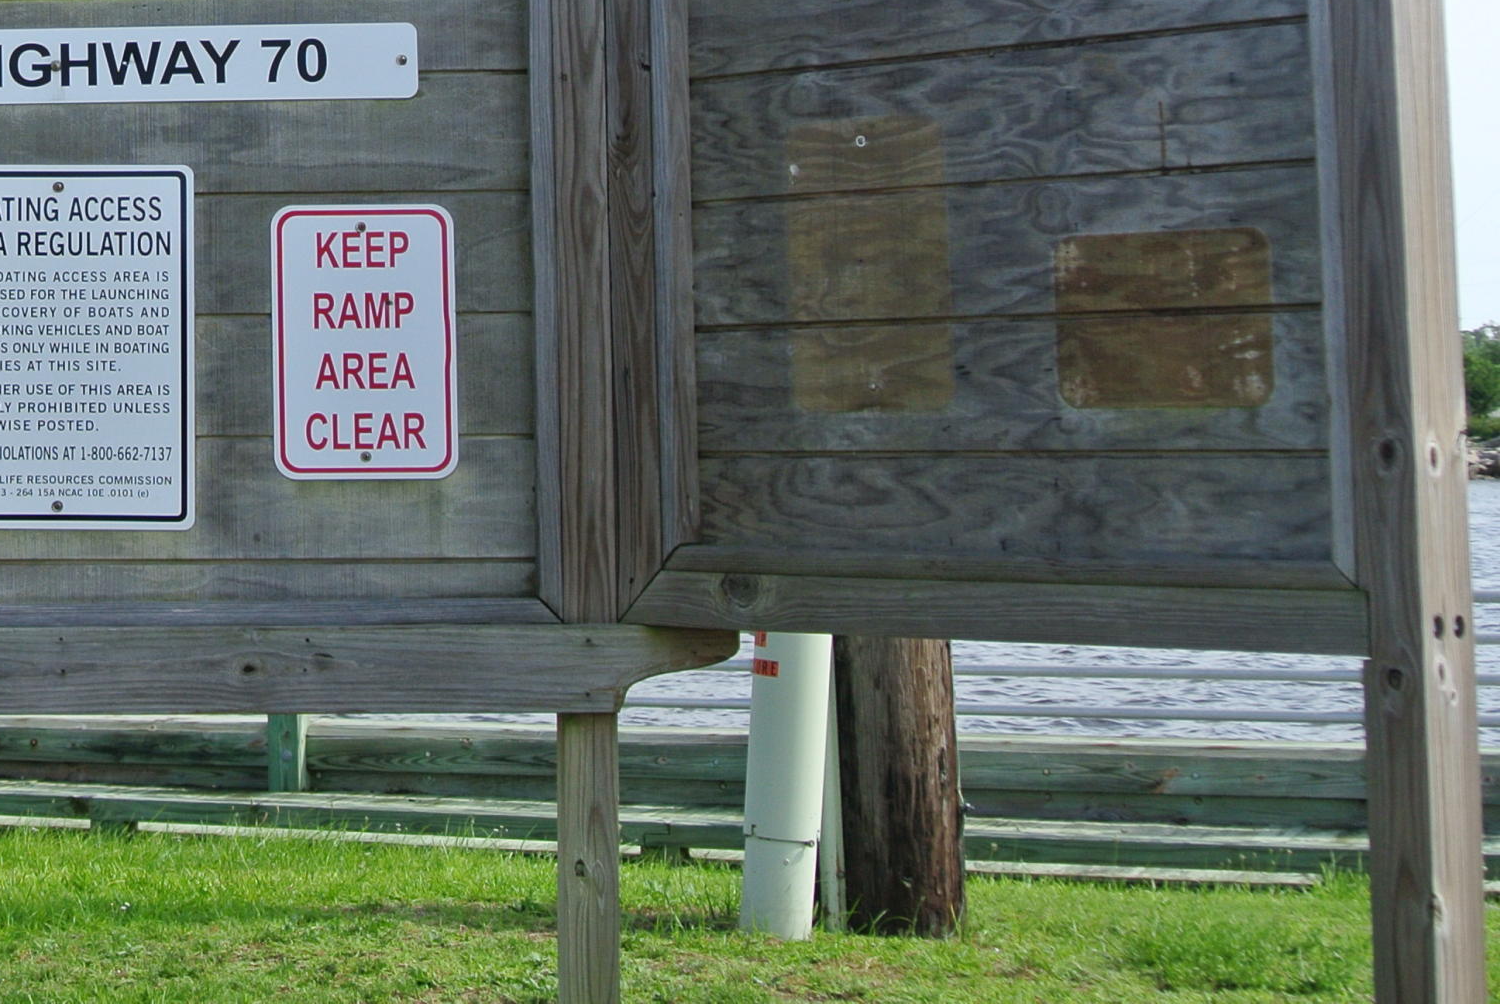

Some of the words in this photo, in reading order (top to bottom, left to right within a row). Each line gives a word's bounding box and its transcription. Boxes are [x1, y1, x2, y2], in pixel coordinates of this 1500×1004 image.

[260, 37, 328, 84] 70
[68, 196, 162, 222] ACCESS
[17, 230, 171, 257] REGULATION
[316, 231, 409, 269] KEEP
[52, 270, 107, 283] ACCESS
[113, 270, 150, 283] AREA
[156, 270, 169, 283] IS
[30, 288, 56, 301] FOR
[60, 288, 87, 301] THE
[91, 288, 170, 301] LAUNCHING
[63, 306, 82, 318] OF
[88, 306, 134, 318] BOATS
[140, 306, 170, 319] AND
[313, 292, 415, 329] RAMP
[37, 324, 101, 336] VEHICLES
[105, 324, 133, 336] AND
[137, 324, 170, 336] BOAT
[12, 342, 45, 354] ONLY
[49, 341, 91, 354] WHILE
[95, 342, 109, 354] IN
[113, 341, 170, 354] BOATING
[26, 359, 43, 372] AT
[47, 359, 80, 372] THIS
[86, 359, 122, 372] SITE.
[315, 352, 416, 390] AREA
[25, 383, 53, 396] USE
[57, 383, 76, 396] OF
[79, 383, 112, 396] THIS
[116, 384, 153, 396] AREA
[157, 384, 170, 396] IS
[17, 401, 107, 414] PROHIBITED
[113, 402, 171, 414] UNLESS
[37, 419, 99, 432] POSTED.
[306, 412, 428, 450] CLEAR
[62, 445, 77, 461] AT
[81, 445, 173, 462] 1-800-662-7137
[26, 474, 95, 485] RESOURCES
[98, 475, 172, 486] COMMISSION
